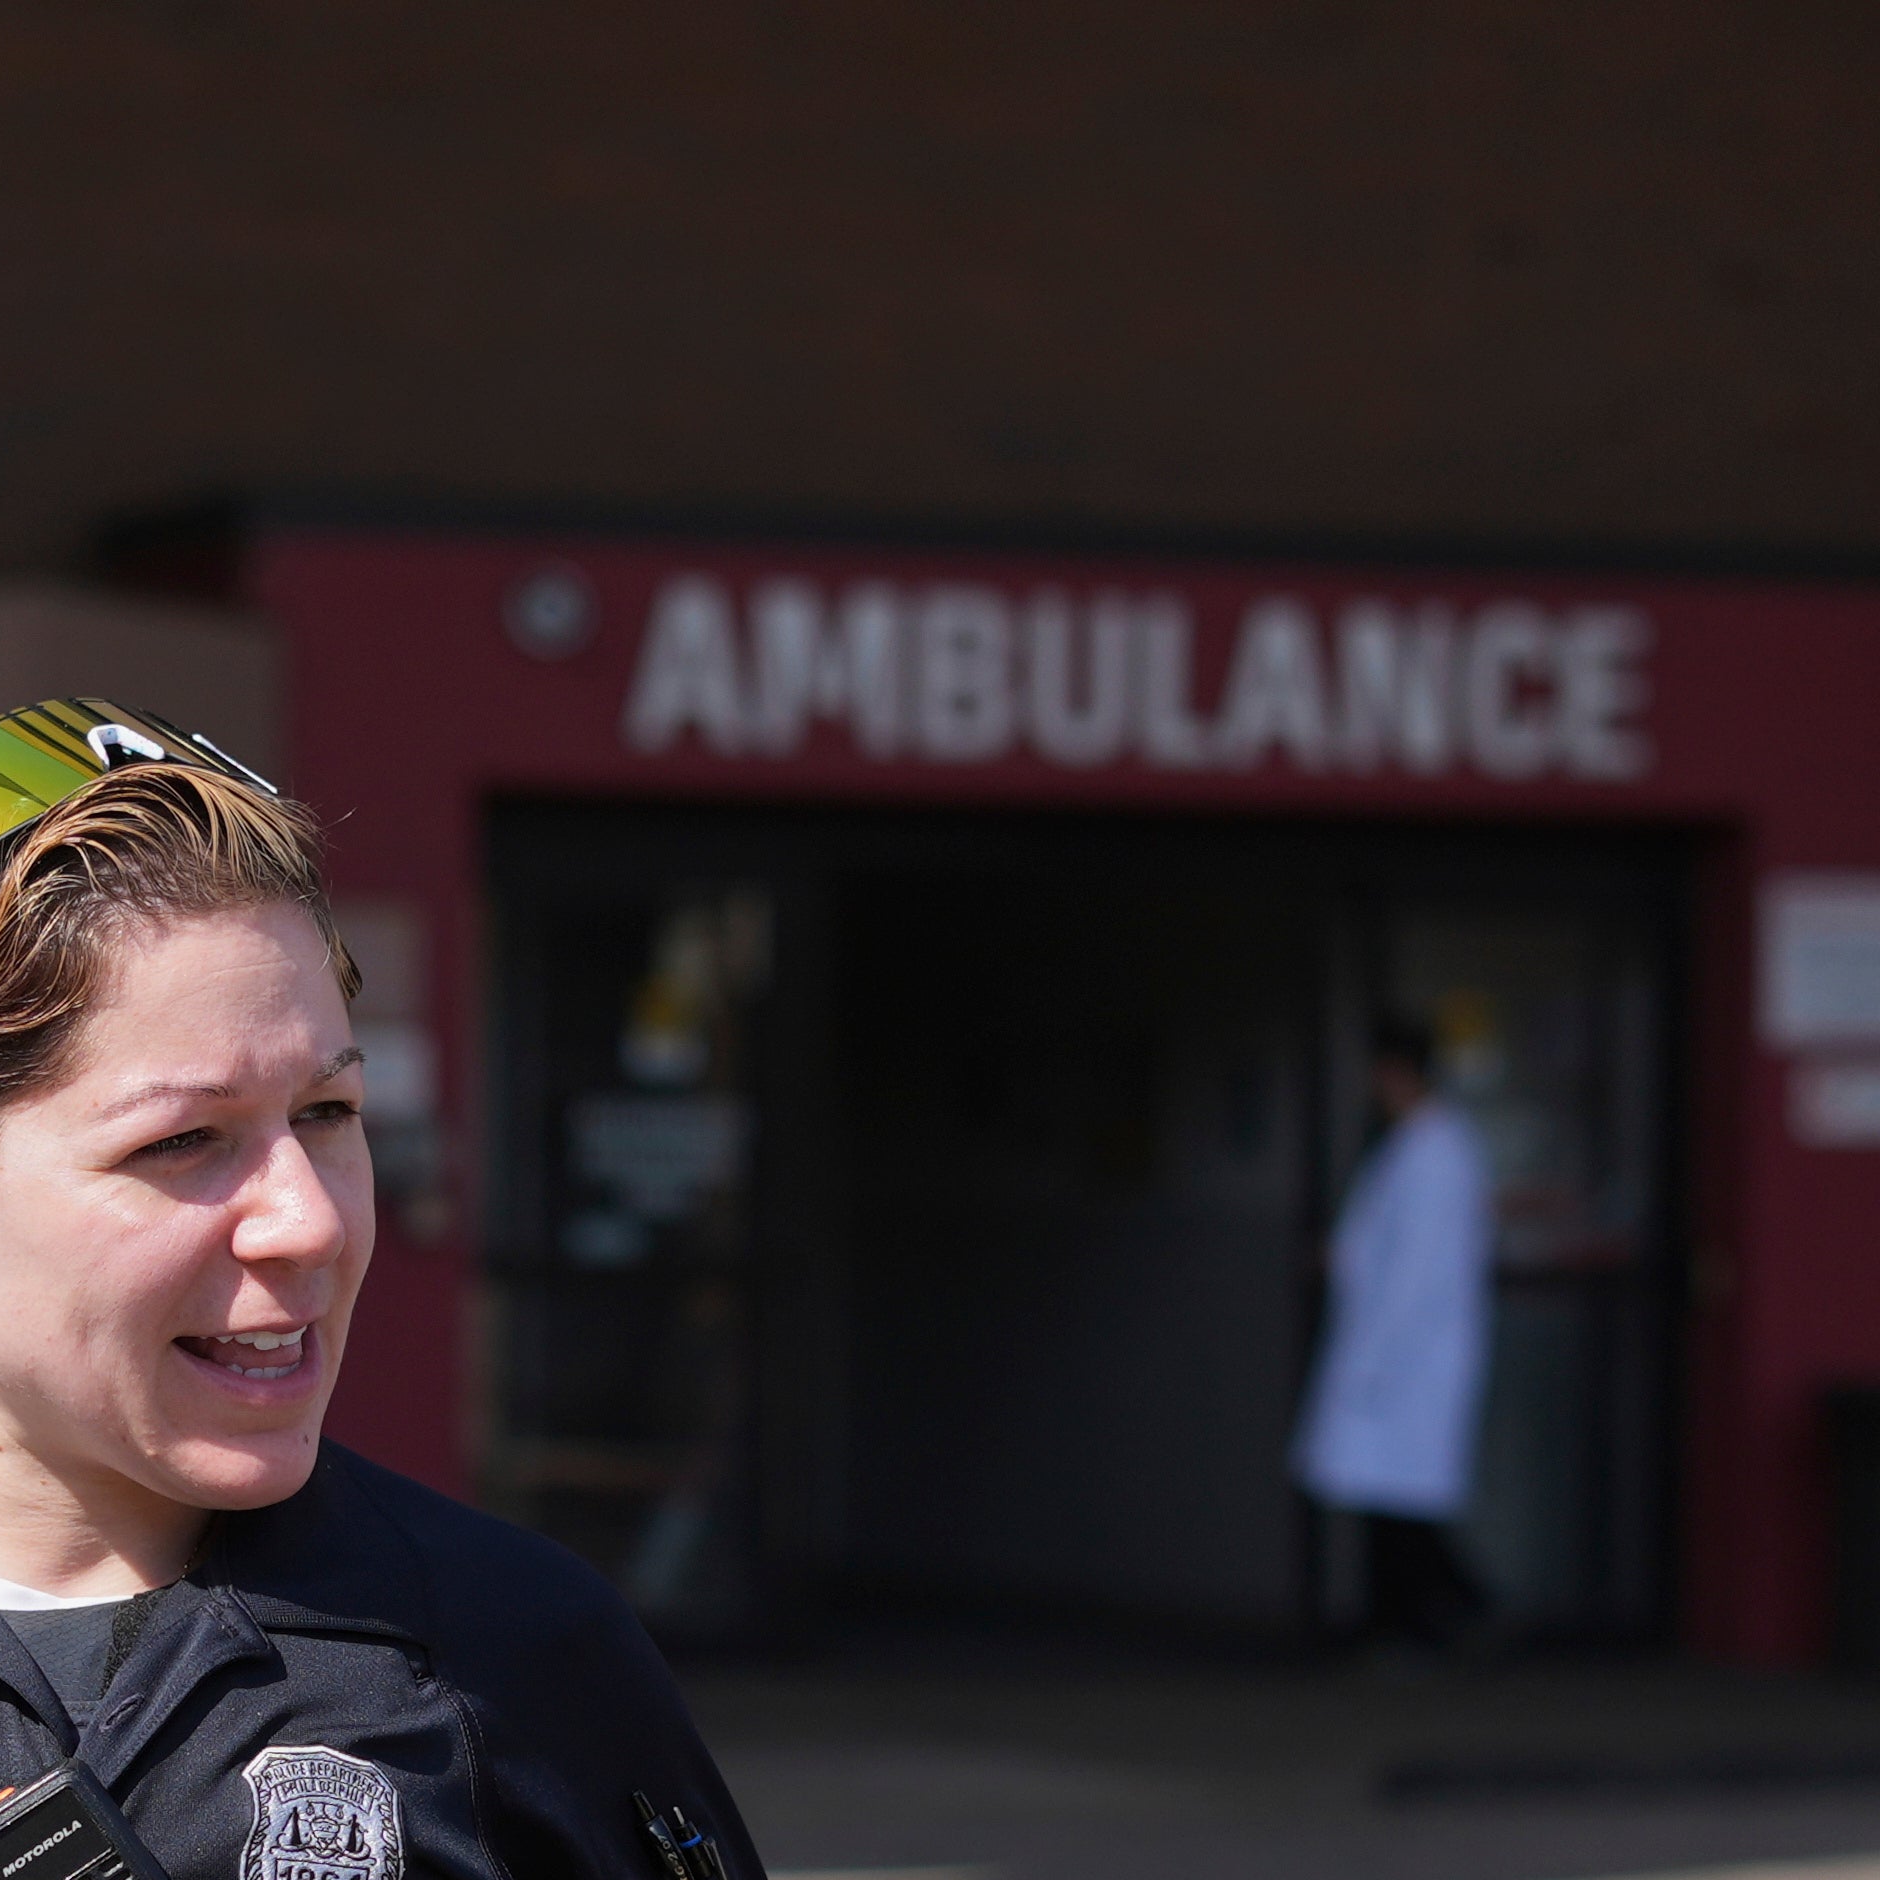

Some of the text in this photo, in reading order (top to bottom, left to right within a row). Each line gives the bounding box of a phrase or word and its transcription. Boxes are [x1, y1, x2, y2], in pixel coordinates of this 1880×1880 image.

[628, 578, 1650, 780] AMBULANCE
[265, 1762, 306, 1782] POLICE
[2, 1819, 83, 1878] MOTOROLA
